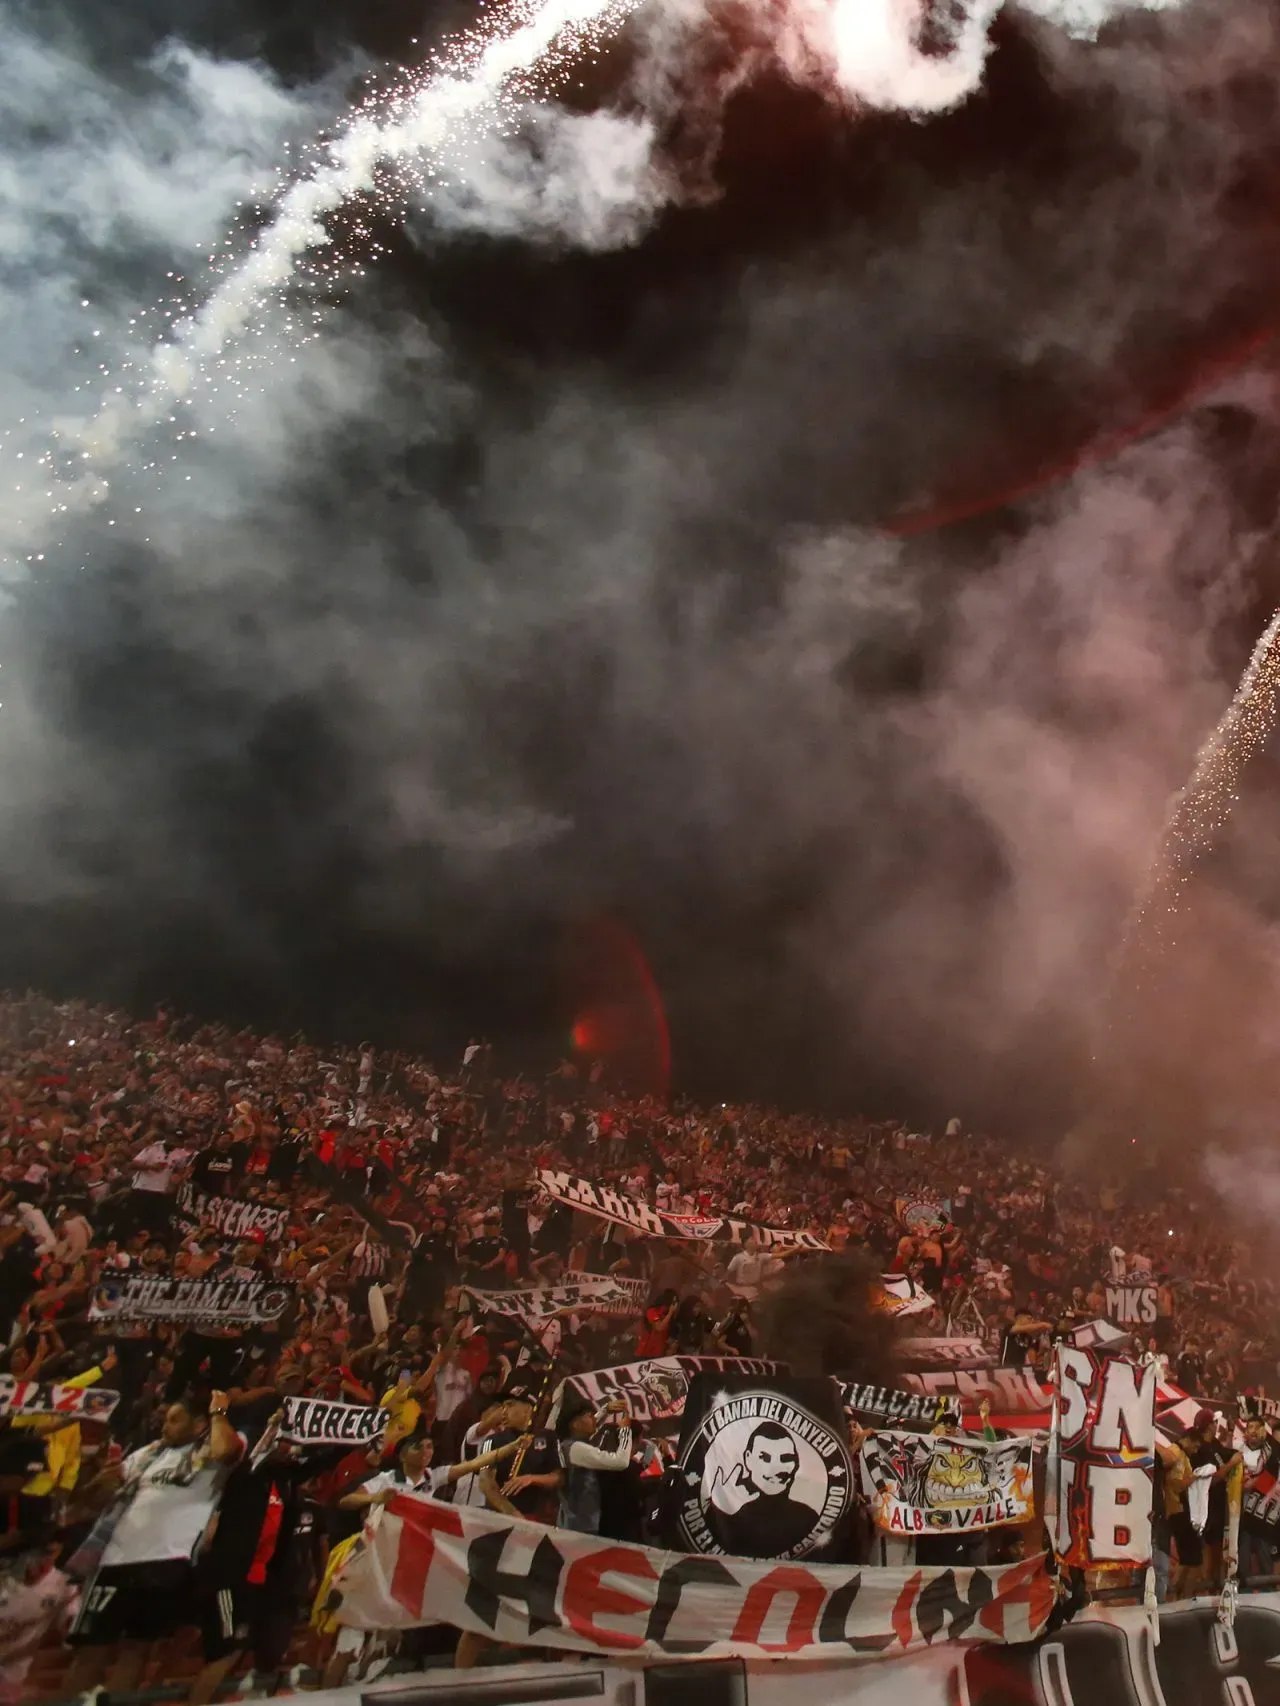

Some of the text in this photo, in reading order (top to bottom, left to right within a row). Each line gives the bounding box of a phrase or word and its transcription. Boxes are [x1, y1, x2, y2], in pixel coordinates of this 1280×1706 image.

[123, 1278, 172, 1310] THE
[1105, 1287, 1158, 1324] MKS
[717, 1398, 757, 1428] BANDA
[759, 1398, 781, 1422] DEL
[781, 1410, 838, 1458] DANYELO
[684, 1498, 705, 1533] POR
[955, 1498, 1017, 1529] VALLE
